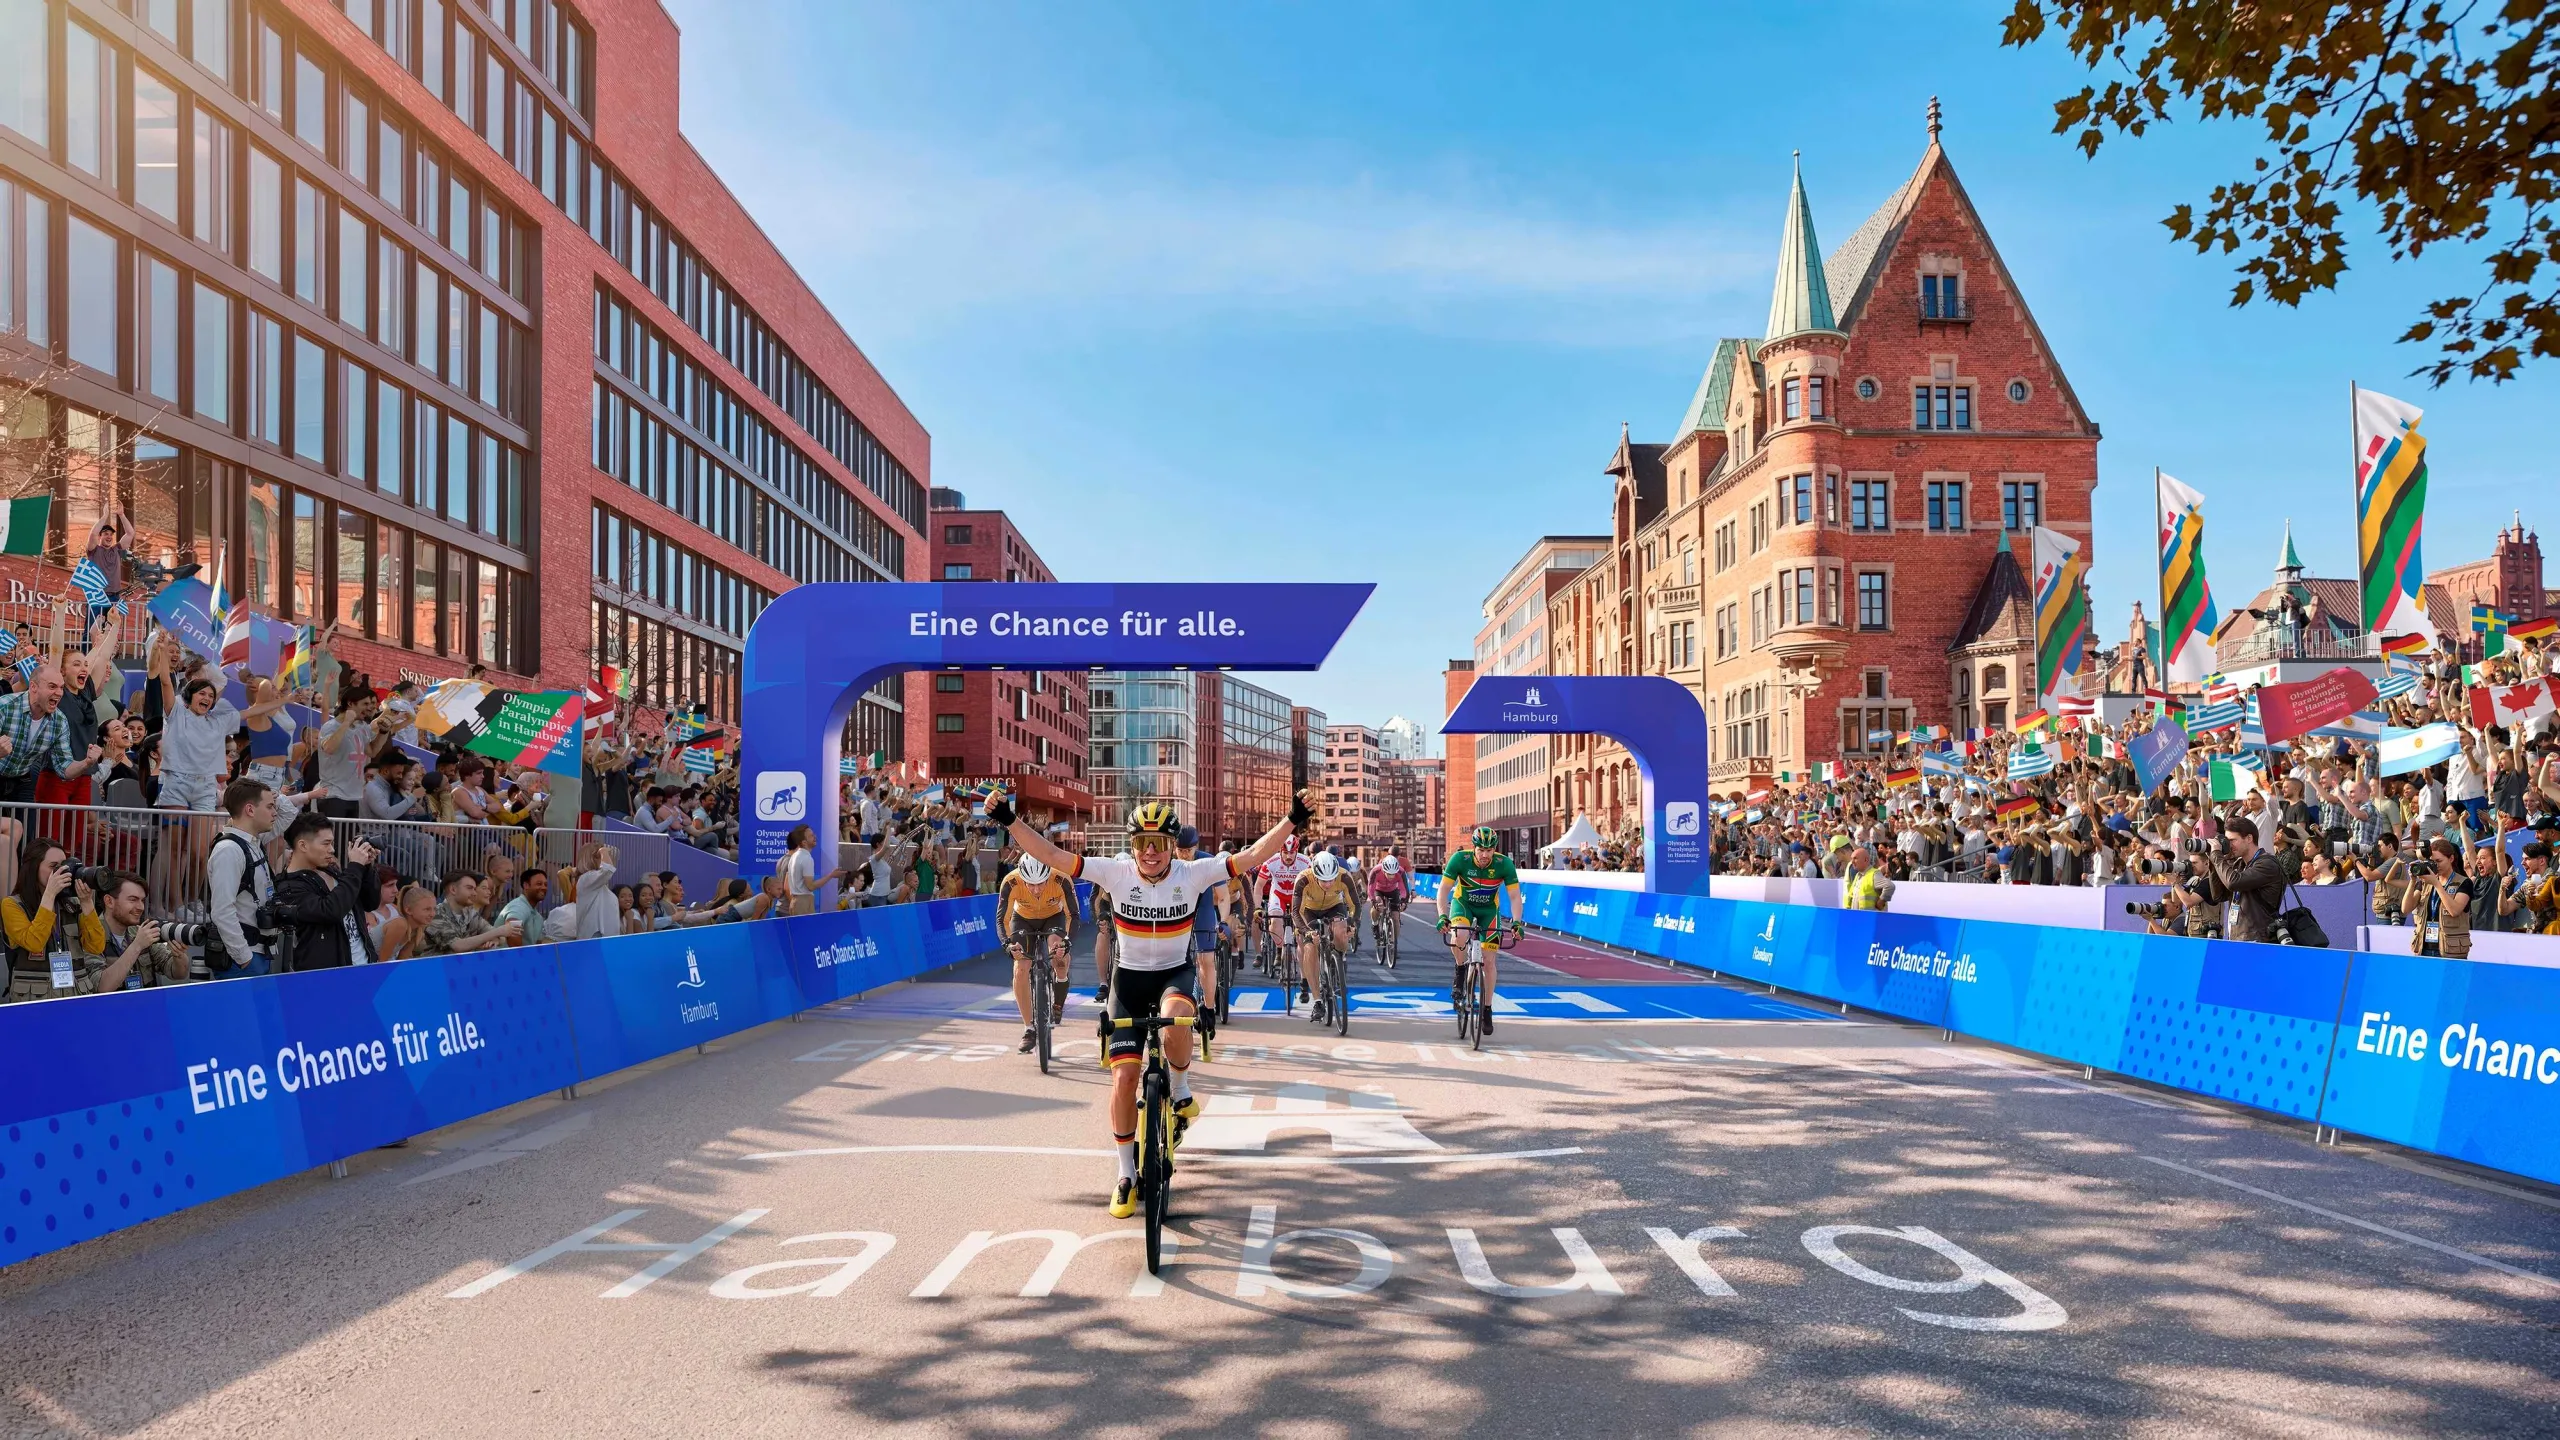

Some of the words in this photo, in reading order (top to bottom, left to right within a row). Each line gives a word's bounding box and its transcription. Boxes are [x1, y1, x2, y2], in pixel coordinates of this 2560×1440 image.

[910, 610, 977, 636] Eine
[989, 610, 1109, 636] Chance
[1119, 610, 1168, 636] für
[1178, 610, 1245, 637] alle.
[2289, 682, 2326, 701] Olympia
[2328, 677, 2336, 685] &
[2291, 682, 2345, 709] Paralympics
[503, 692, 551, 716] Olympia
[554, 708, 565, 719] &
[2293, 707, 2303, 717] in
[2305, 691, 2348, 712] Hamburg.
[500, 704, 573, 734] Paralympics
[1503, 711, 1558, 725] Hamburg
[496, 733, 512, 742] Eine
[512, 738, 539, 749] Chance
[498, 717, 511, 730] in
[513, 722, 574, 748] Hamburg.
[2149, 737, 2186, 780] Hamburg
[756, 829, 790, 838] Olympia
[756, 838, 788, 847] Paralym
[756, 847, 765, 855] in
[766, 847, 790, 855] Hamb
[1120, 902, 1188, 919] DEUTSCHLAND
[813, 945, 832, 969] Eine
[831, 942, 856, 965] Chance
[1867, 942, 1890, 968] Eine
[1891, 946, 1931, 974] Chance
[1932, 950, 1951, 978] für
[1951, 953, 1977, 983] alle.
[680, 999, 719, 1025] Hamburg
[2356, 1011, 2428, 1061] Eine
[2439, 1022, 2560, 1085] Chanc
[186, 1057, 268, 1114] Eine
[277, 1041, 387, 1093] Chance
[392, 1022, 429, 1067] für
[436, 1012, 486, 1057] alle.
[445, 1204, 2069, 1332] Hamburg
